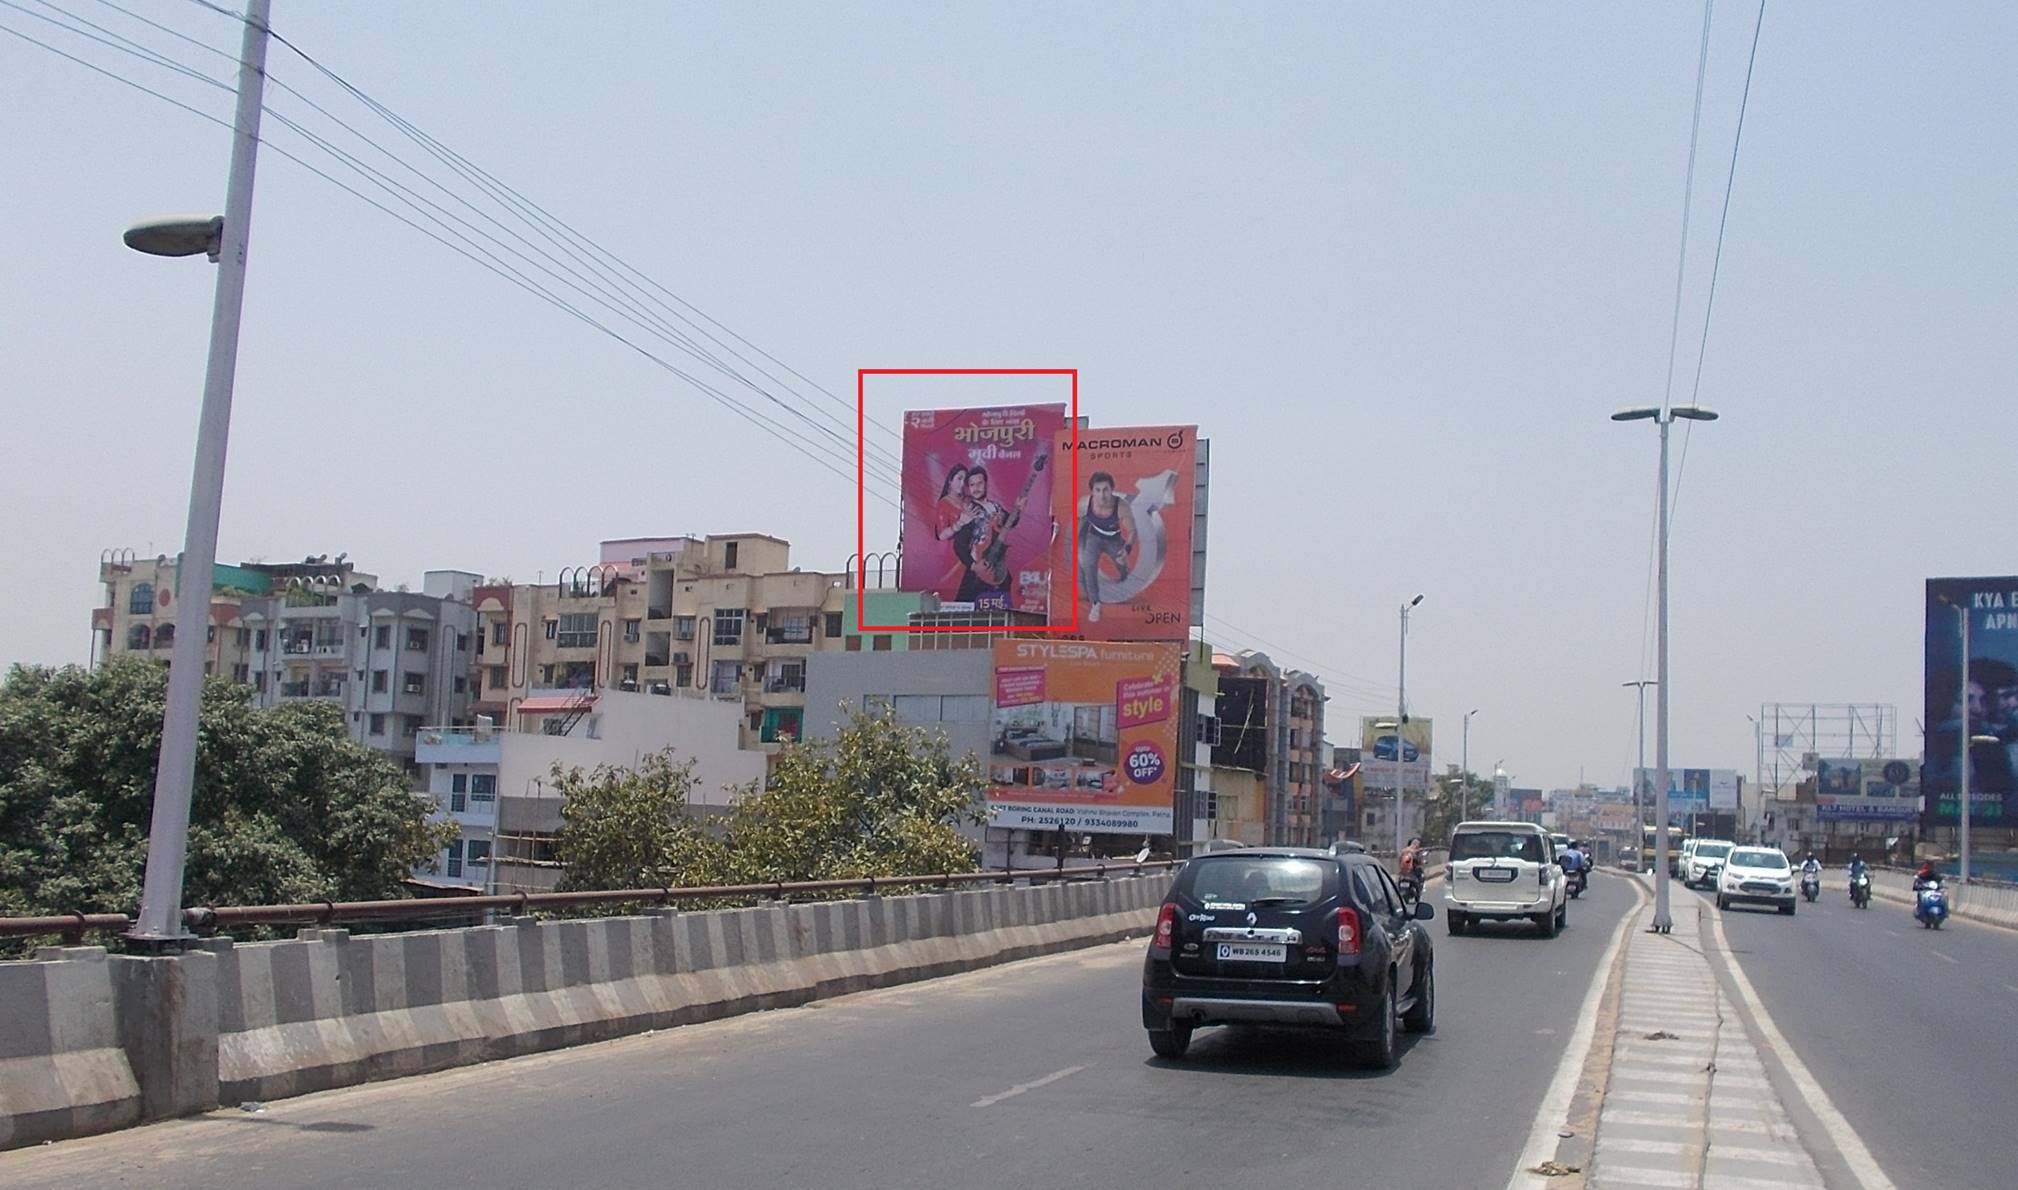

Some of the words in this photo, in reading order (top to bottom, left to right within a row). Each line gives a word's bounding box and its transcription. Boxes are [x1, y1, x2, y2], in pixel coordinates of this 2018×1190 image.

[954, 418, 1035, 447] भोजपुरी
[1062, 438, 1162, 450] MACROMAN
[968, 444, 996, 464] मूवी
[1090, 451, 1132, 460] SPORTS
[979, 598, 990, 609] 15
[1974, 592, 2005, 608] KYA
[1016, 644, 1098, 659] STYLESPA
[1101, 648, 1154, 661] furniture
[1122, 695, 1163, 719] style
[1129, 753, 1160, 768] 60%
[1940, 792, 1955, 800] ALL
[1008, 805, 1032, 813] BORING
[1033, 806, 1054, 814] CANAL
[1039, 816, 1076, 825] 2526120
[1084, 818, 1139, 828] 9334089980
